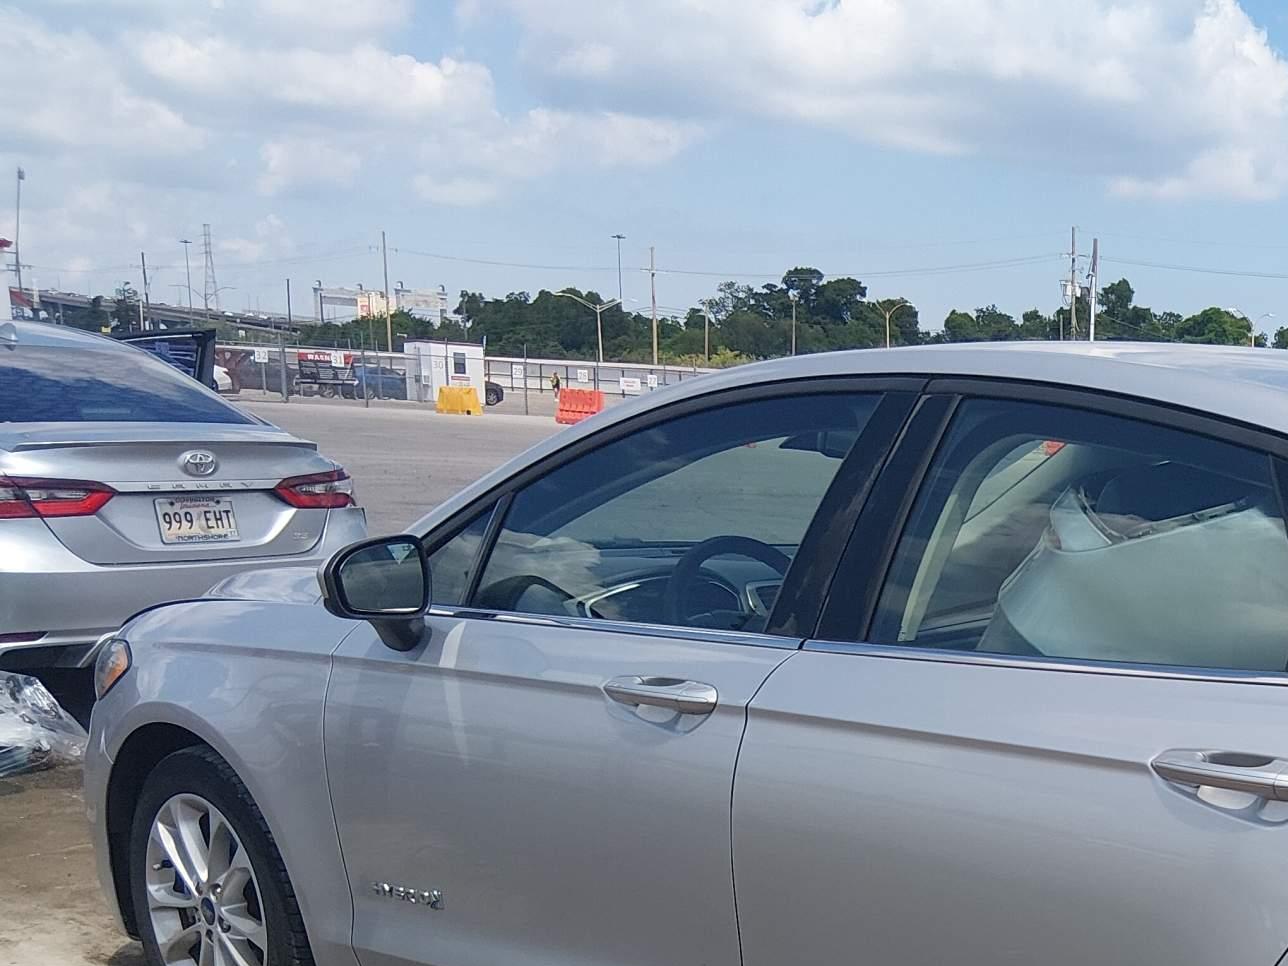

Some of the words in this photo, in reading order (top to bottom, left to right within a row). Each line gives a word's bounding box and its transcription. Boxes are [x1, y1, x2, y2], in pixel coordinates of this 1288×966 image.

[433, 360, 444, 369] 30
[163, 511, 194, 531] 999
[203, 509, 232, 530] EHT
